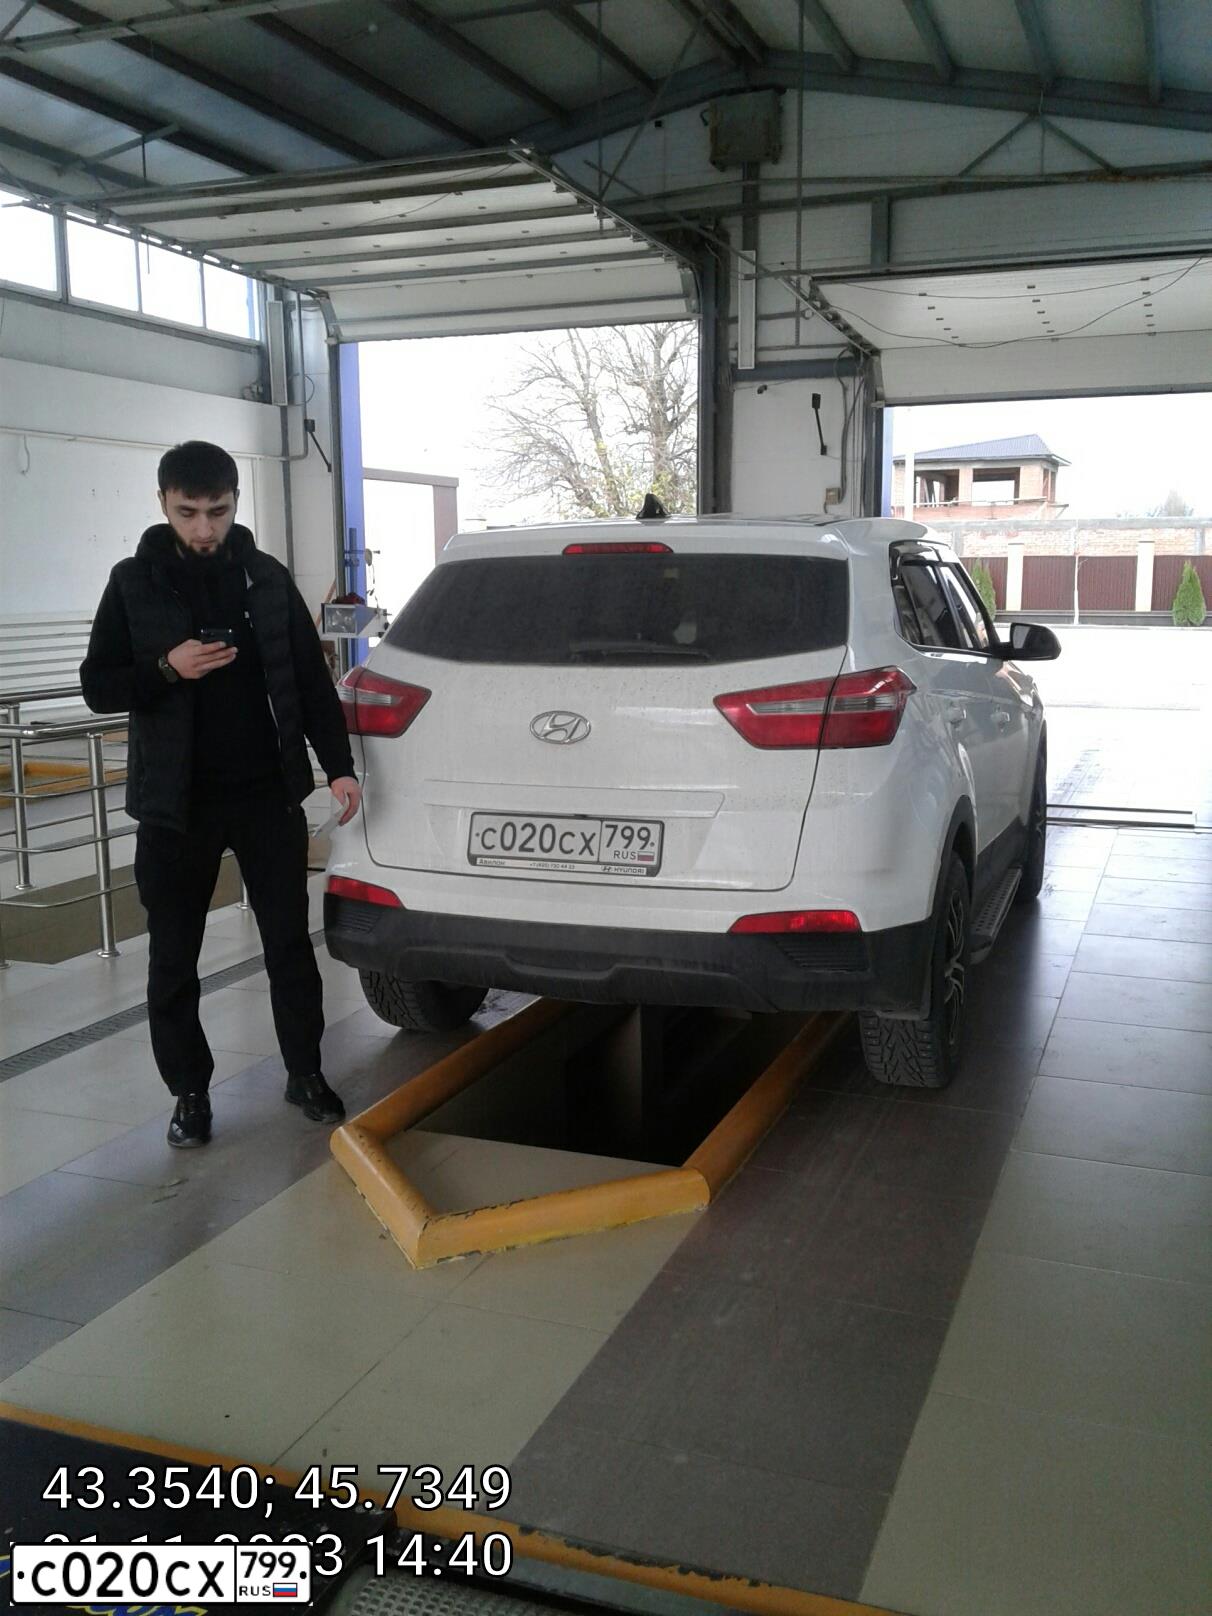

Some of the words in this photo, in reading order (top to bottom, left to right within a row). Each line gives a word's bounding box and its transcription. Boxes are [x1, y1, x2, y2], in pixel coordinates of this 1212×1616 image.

[605, 824, 651, 850] 799
[613, 850, 637, 860] RUS
[613, 866, 645, 875] HYUNDAI
